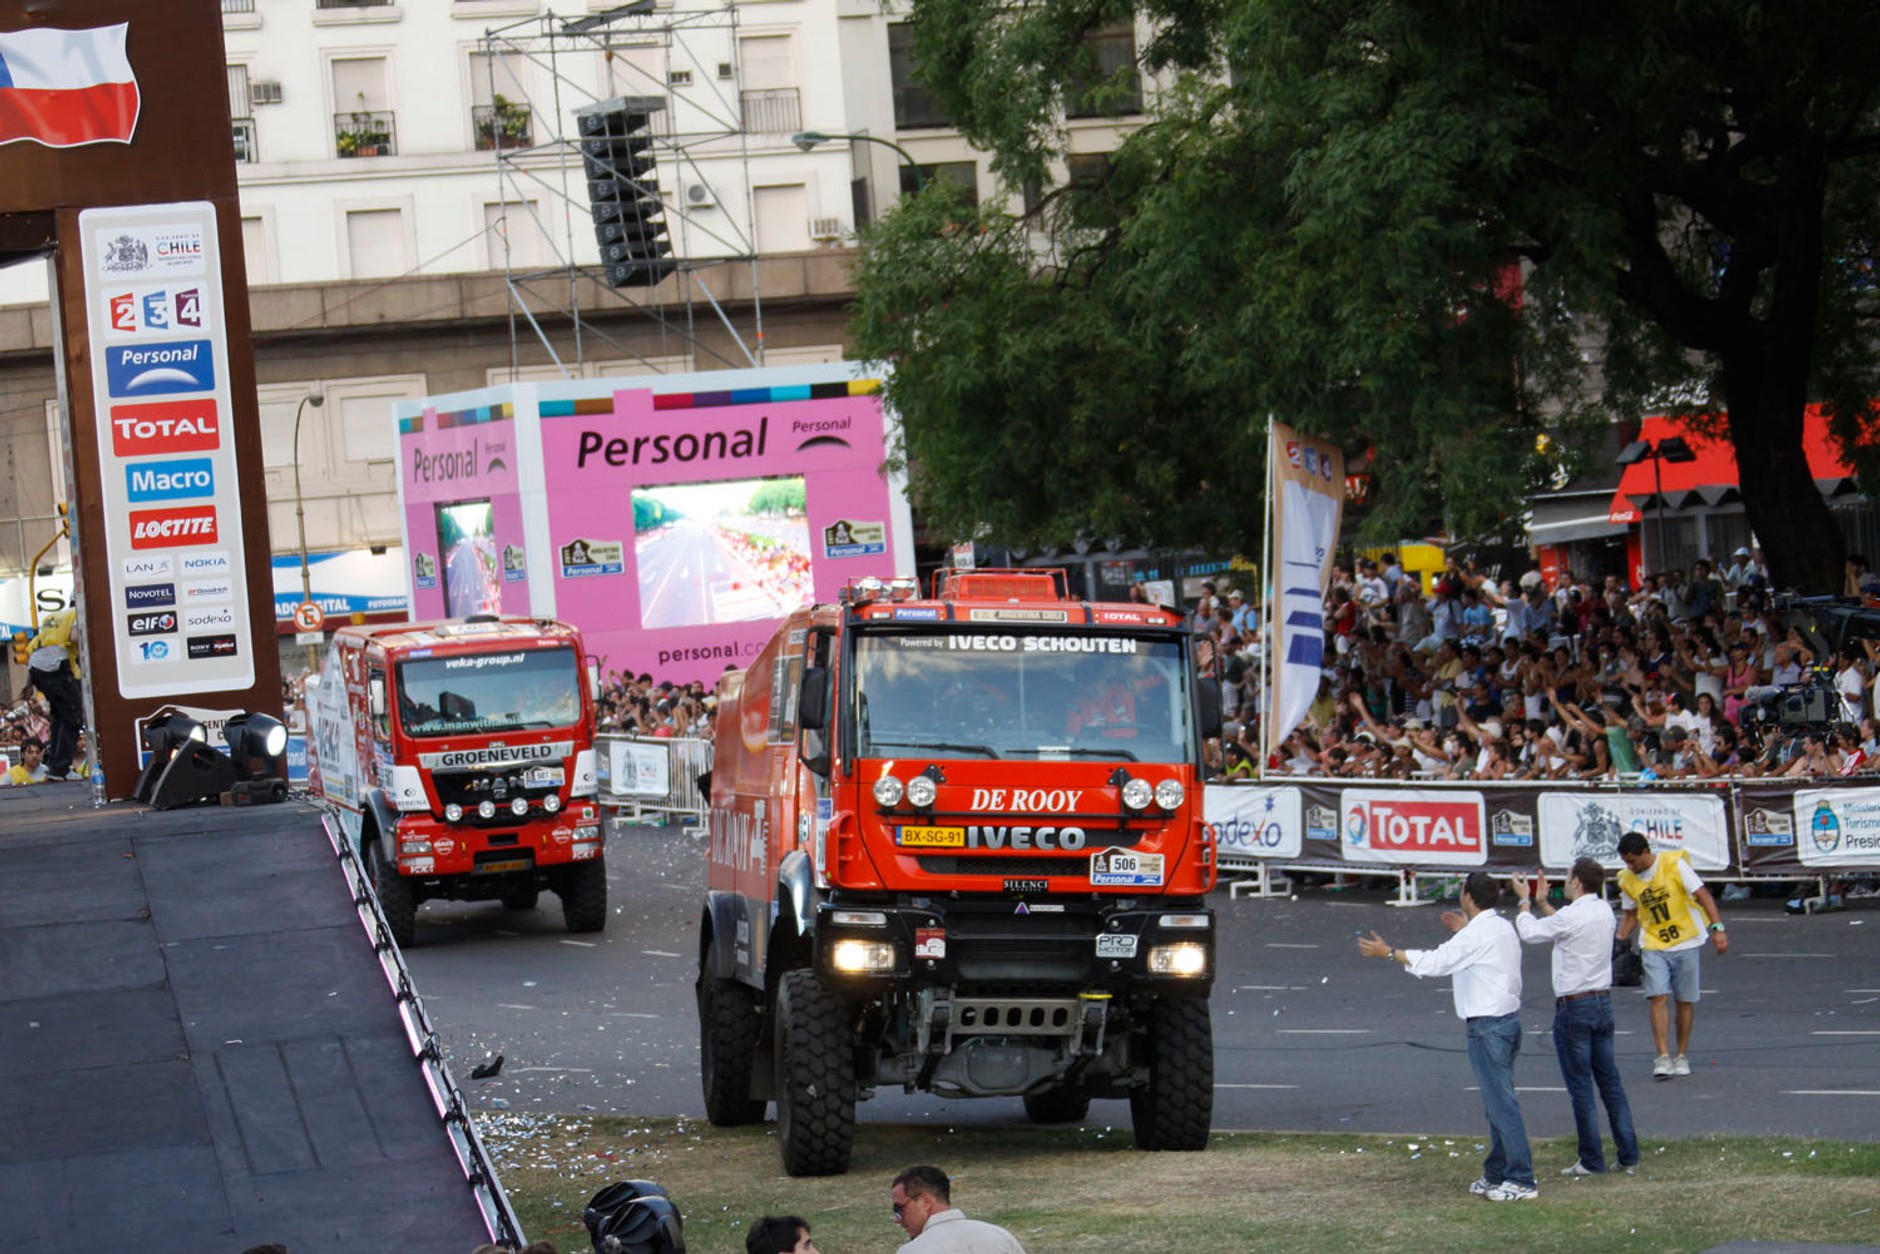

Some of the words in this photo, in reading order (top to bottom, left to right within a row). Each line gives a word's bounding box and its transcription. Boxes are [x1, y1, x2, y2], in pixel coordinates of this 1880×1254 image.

[156, 241, 200, 255] CHILE
[116, 303, 134, 328] 2
[149, 301, 168, 326] 3
[181, 298, 200, 323] 4
[122, 345, 198, 365] Personal
[114, 417, 216, 439] TOTAL
[577, 417, 768, 468] Personal
[792, 416, 851, 433] Personal
[413, 437, 478, 483] Personal
[132, 470, 211, 492] Macro
[134, 517, 214, 539] LOCTITE
[126, 563, 154, 573] LAN
[185, 558, 226, 568] NOKIA
[566, 566, 602, 576] Personal
[129, 589, 172, 599] NOVOTEL
[188, 613, 232, 626] sodexo
[896, 608, 936, 617] Personal
[132, 617, 158, 630] elf
[658, 641, 766, 666] personal.co
[900, 638, 932, 648] Powered
[933, 638, 944, 649] by
[949, 635, 1017, 651] IVECO
[1023, 636, 1137, 653] SCHOUTEN
[446, 652, 525, 670] veka-group.nl
[442, 746, 553, 767] GROENEVELD
[970, 789, 1007, 811] DE
[1009, 789, 1084, 812] ROOY
[1372, 807, 1478, 846] TOTAL
[905, 826, 961, 843] BX-SG-91
[967, 826, 1086, 850] IVECO
[1114, 858, 1137, 871] 506
[1095, 874, 1136, 883] Personal
[1650, 901, 1671, 925] TV
[1099, 935, 1136, 946] PRO
[1658, 924, 1680, 943] 58
